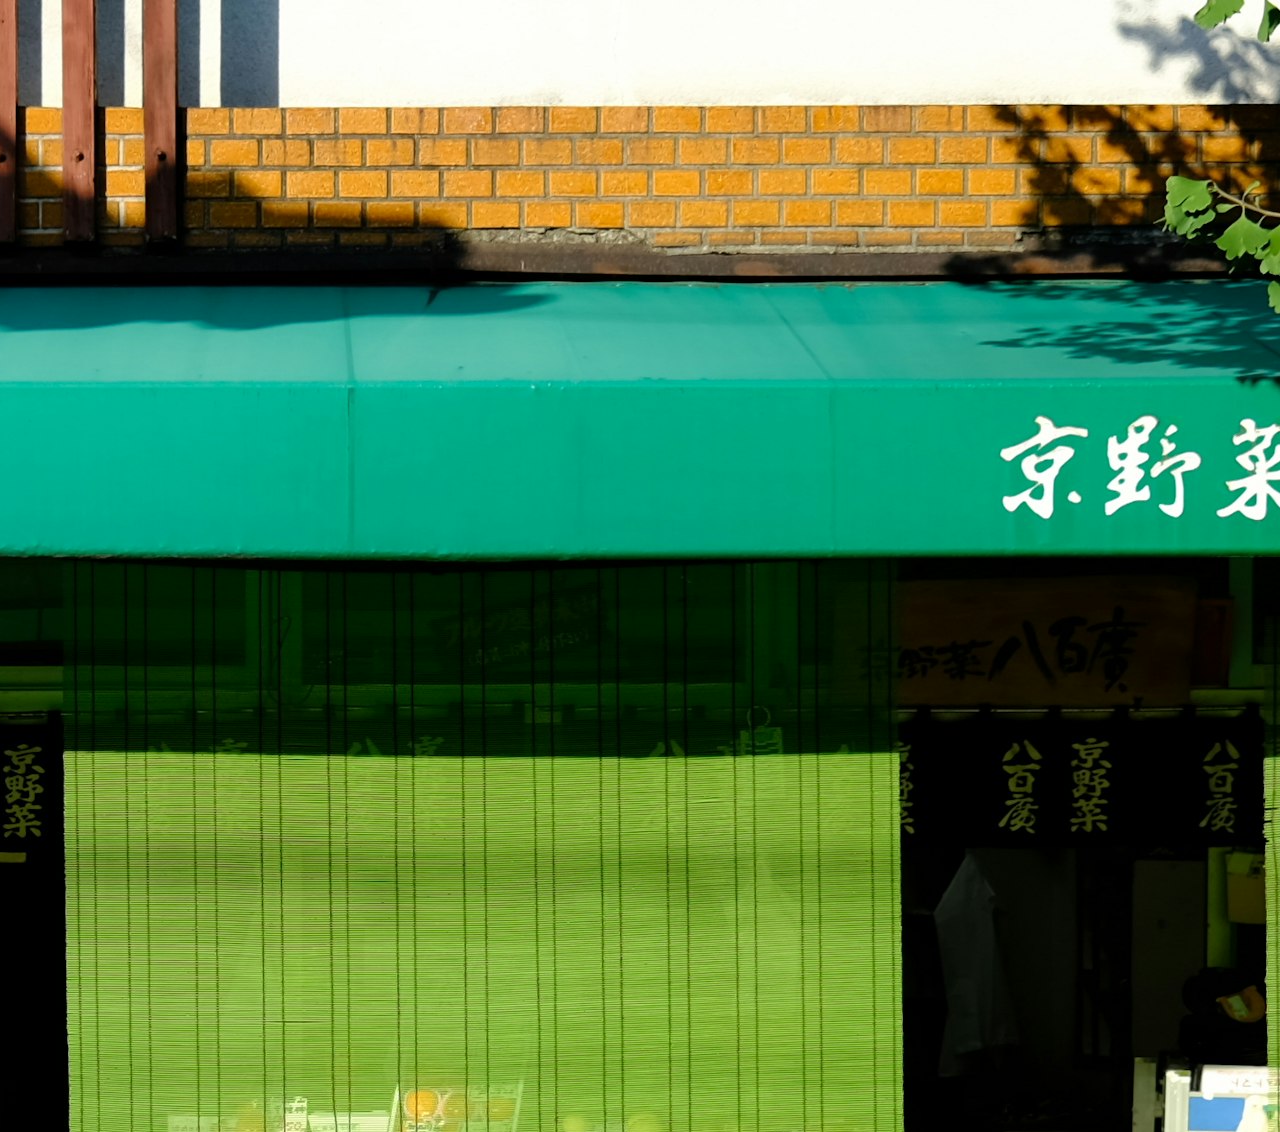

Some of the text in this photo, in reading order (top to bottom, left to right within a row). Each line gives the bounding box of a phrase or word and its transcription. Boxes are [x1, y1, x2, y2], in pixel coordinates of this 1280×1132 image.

[2, 743, 46, 839] 京野菜
[1070, 737, 1113, 833] 京野菜
